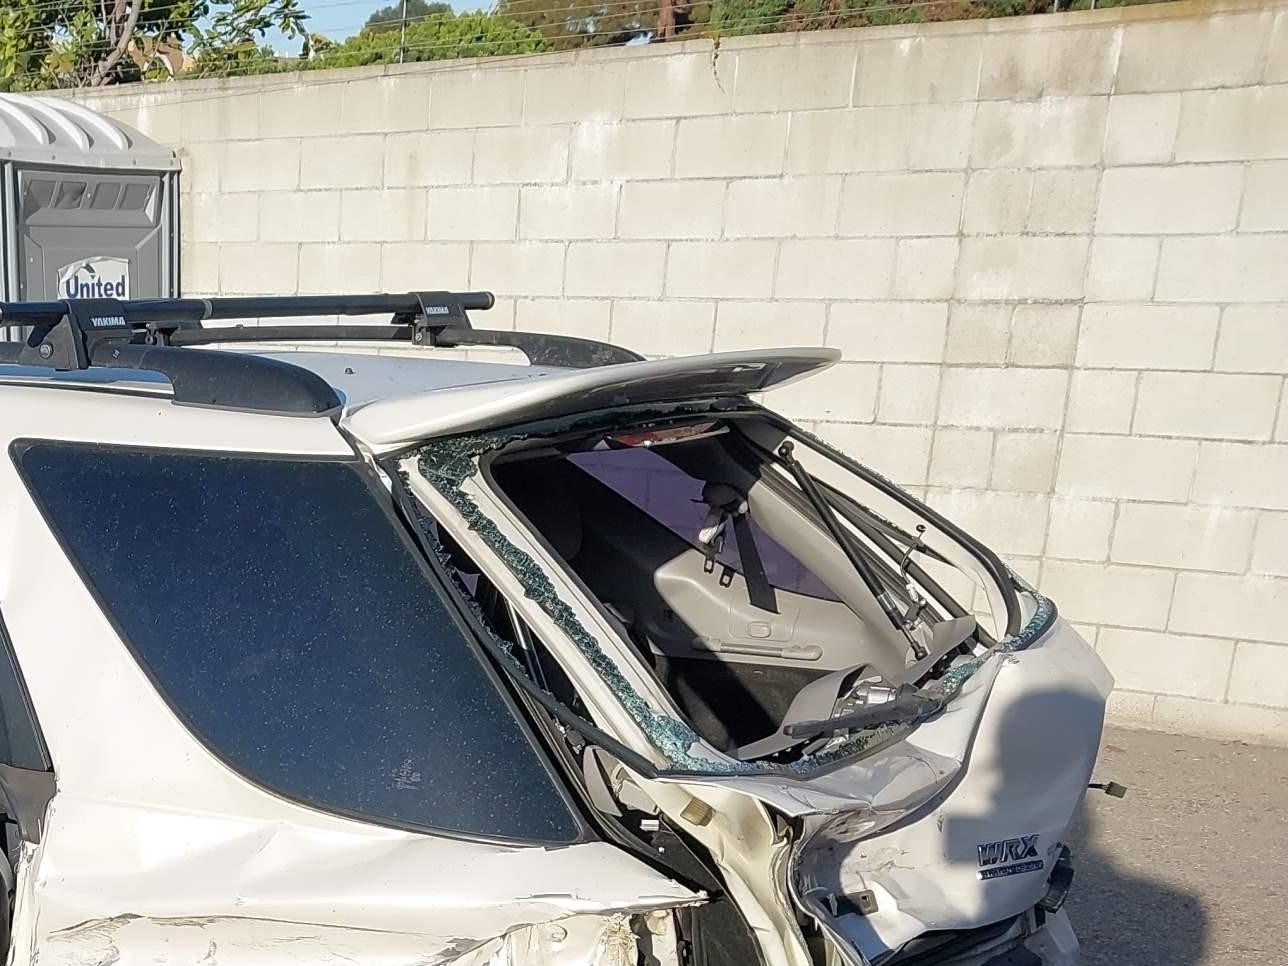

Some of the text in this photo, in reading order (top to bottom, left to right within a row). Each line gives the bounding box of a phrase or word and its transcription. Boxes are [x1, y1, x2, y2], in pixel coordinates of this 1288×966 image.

[65, 274, 125, 299] United
[90, 316, 126, 327] YAKIMA
[976, 833, 1040, 867] WRX
